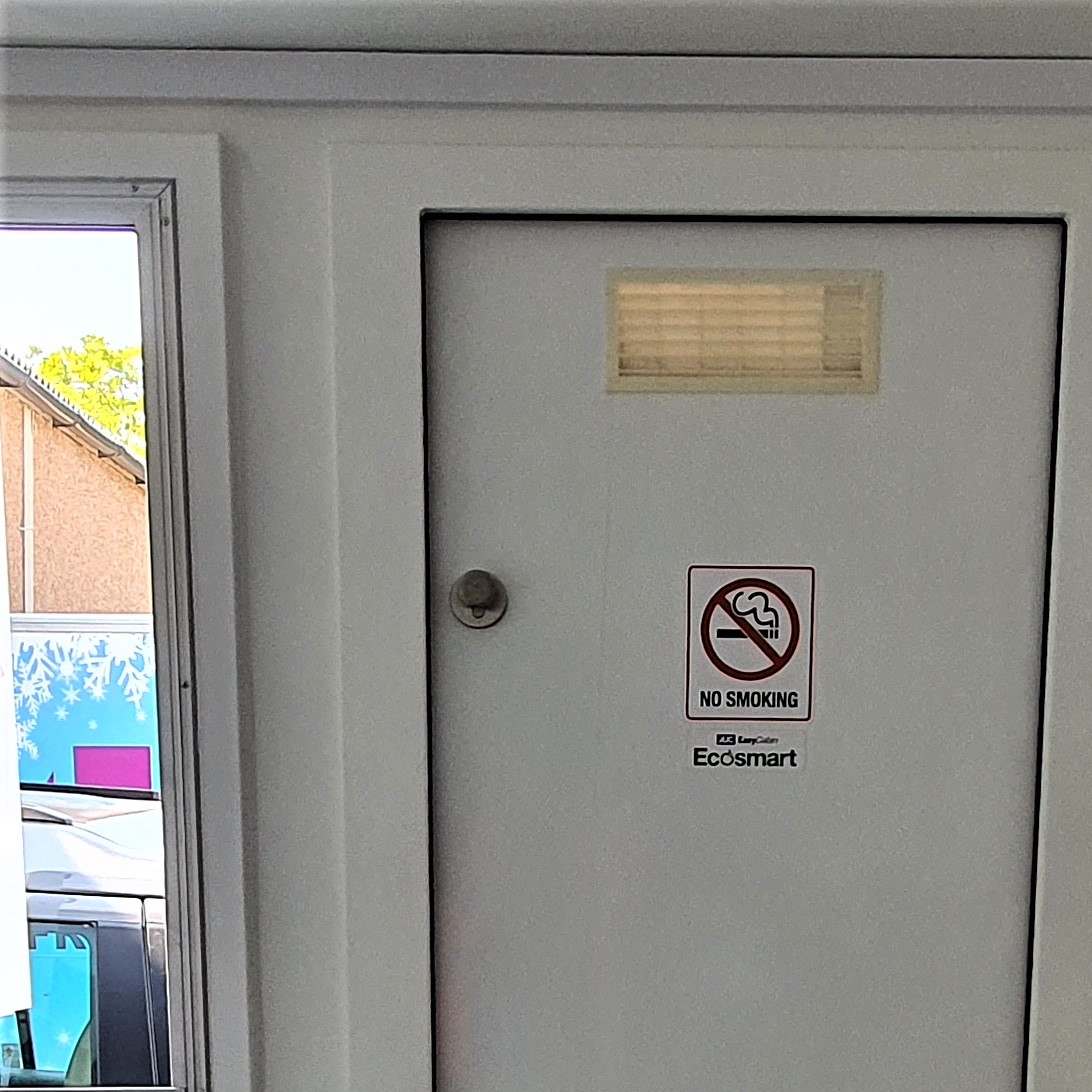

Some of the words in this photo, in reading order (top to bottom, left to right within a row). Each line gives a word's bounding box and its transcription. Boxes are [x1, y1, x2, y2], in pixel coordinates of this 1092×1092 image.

[700, 691, 722, 707] NO
[726, 691, 798, 708] SMOKING
[693, 747, 798, 767] Ecosmart
